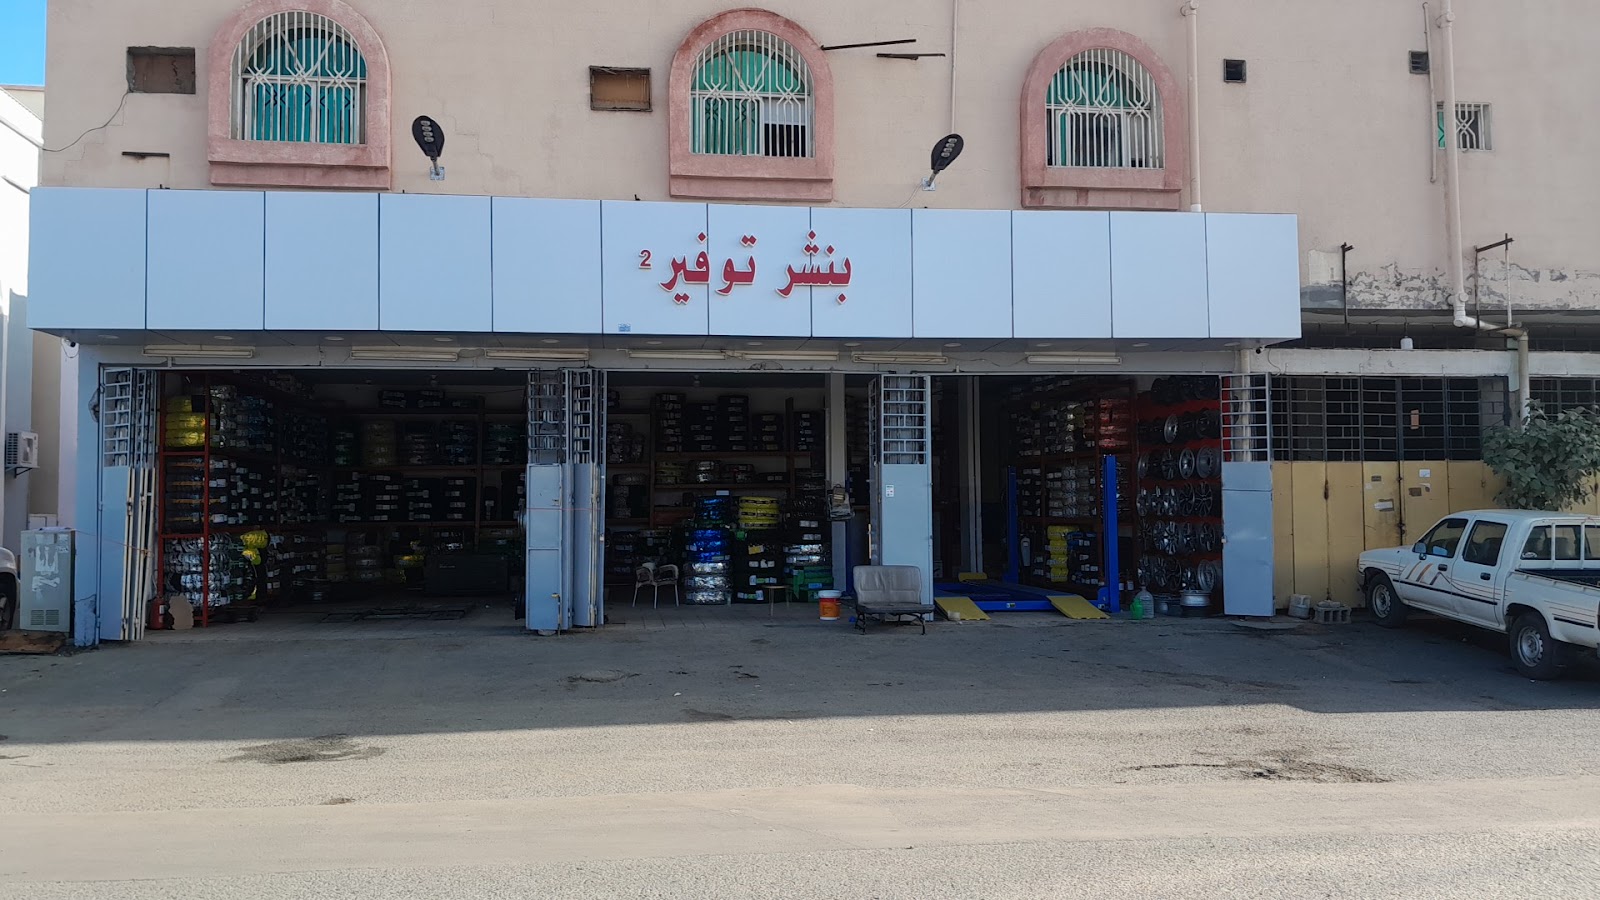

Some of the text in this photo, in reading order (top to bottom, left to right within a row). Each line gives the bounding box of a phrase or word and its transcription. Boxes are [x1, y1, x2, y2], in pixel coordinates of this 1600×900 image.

[639, 230, 852, 304] بنشر توفير 2
